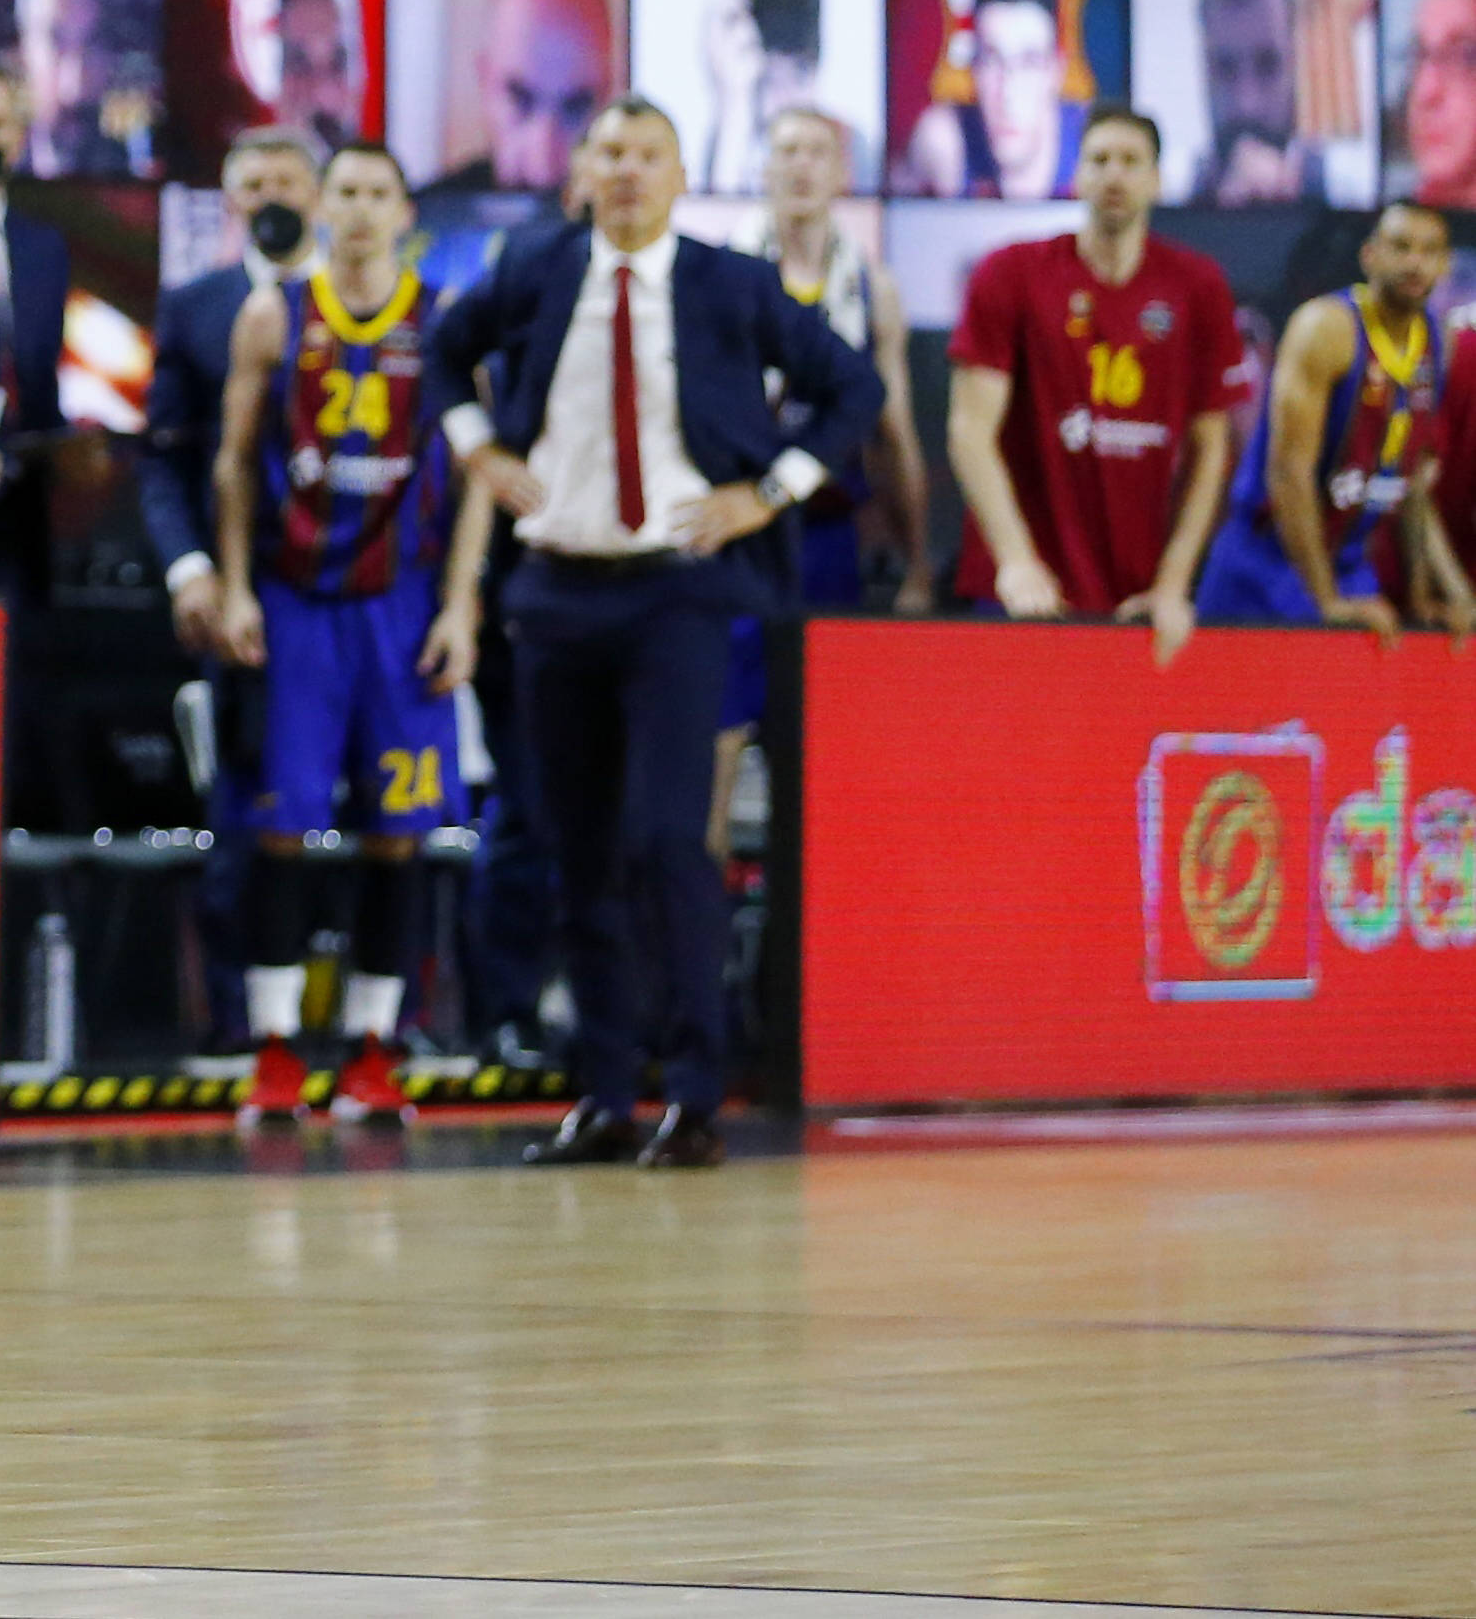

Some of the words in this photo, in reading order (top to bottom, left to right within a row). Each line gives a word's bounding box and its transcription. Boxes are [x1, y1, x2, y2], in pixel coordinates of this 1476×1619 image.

[315, 368, 391, 440] 24
[1087, 341, 1145, 409] 16
[377, 748, 443, 815] 24
